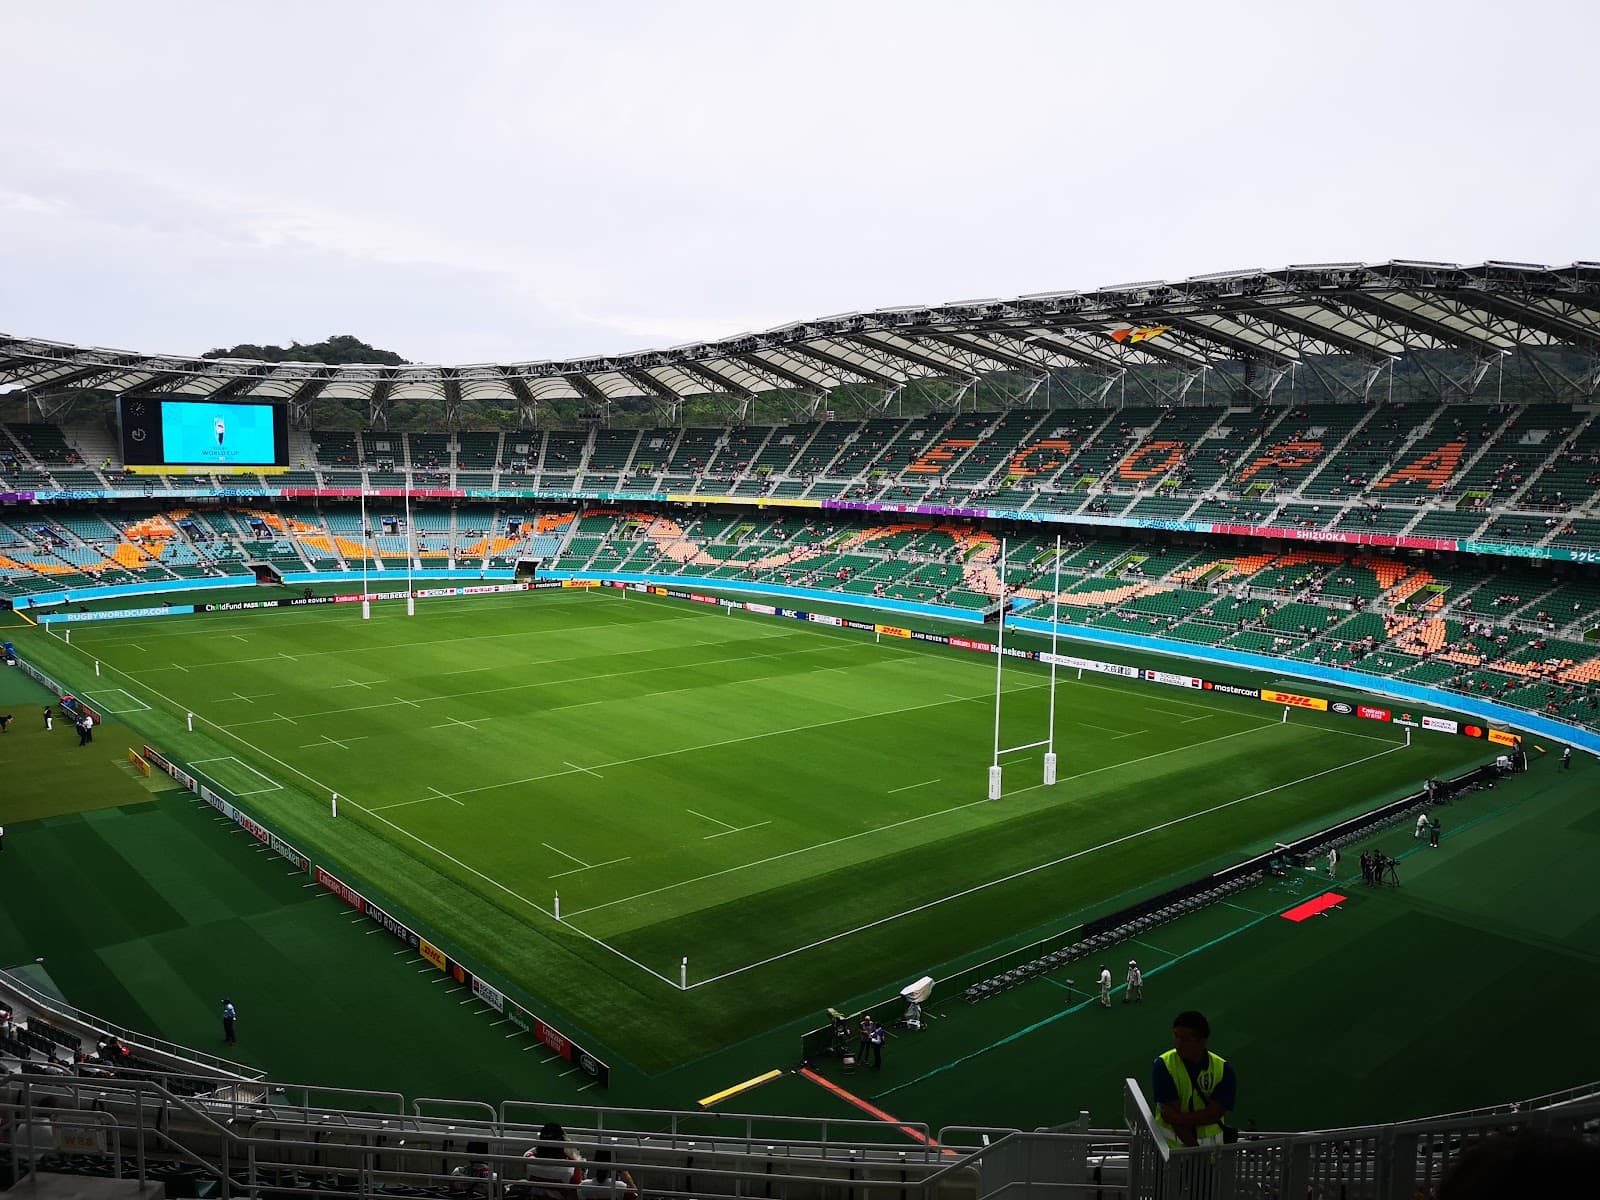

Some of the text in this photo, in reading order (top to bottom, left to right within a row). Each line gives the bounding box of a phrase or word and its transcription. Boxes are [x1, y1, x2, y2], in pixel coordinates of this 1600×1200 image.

[1297, 530, 1347, 541] SHIZUOKA
[68, 606, 169, 621] RUGBYWORLDCUP.COM
[782, 609, 797, 619] NEC
[882, 626, 903, 636] DHL
[925, 634, 943, 643] ROVER
[1214, 683, 1259, 698] mastercard
[1275, 693, 1313, 707] DHL
[271, 835, 300, 868] Heineken
[319, 871, 341, 895] Emirates
[365, 903, 407, 942] LAND ROVER
[424, 946, 442, 964] DHL
